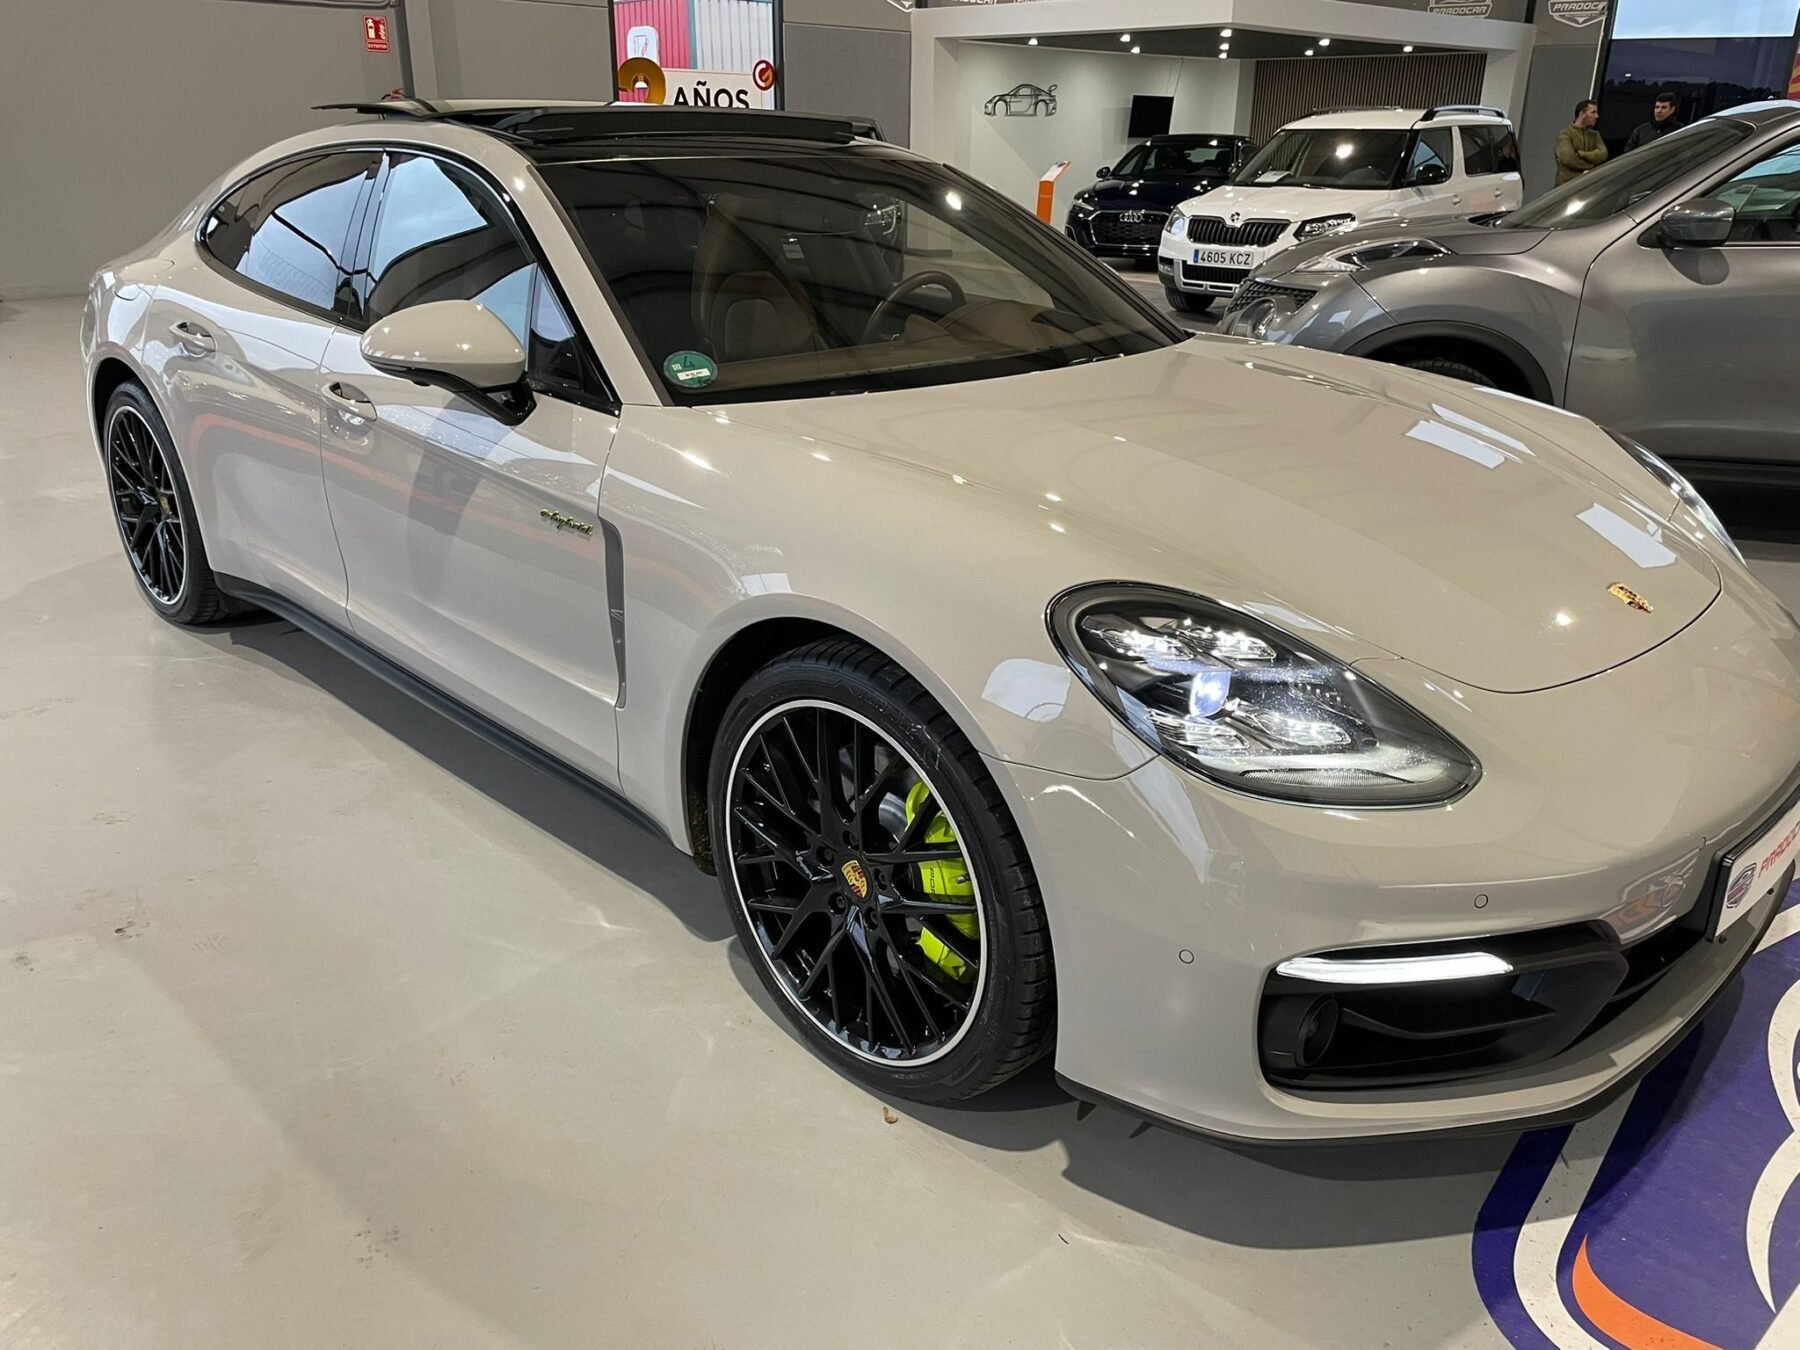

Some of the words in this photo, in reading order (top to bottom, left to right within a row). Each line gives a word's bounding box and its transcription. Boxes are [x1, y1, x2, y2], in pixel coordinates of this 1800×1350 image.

[674, 80, 750, 108] AÑOS
[1200, 251, 1226, 263] 4605
[1229, 252, 1251, 265] KCZ
